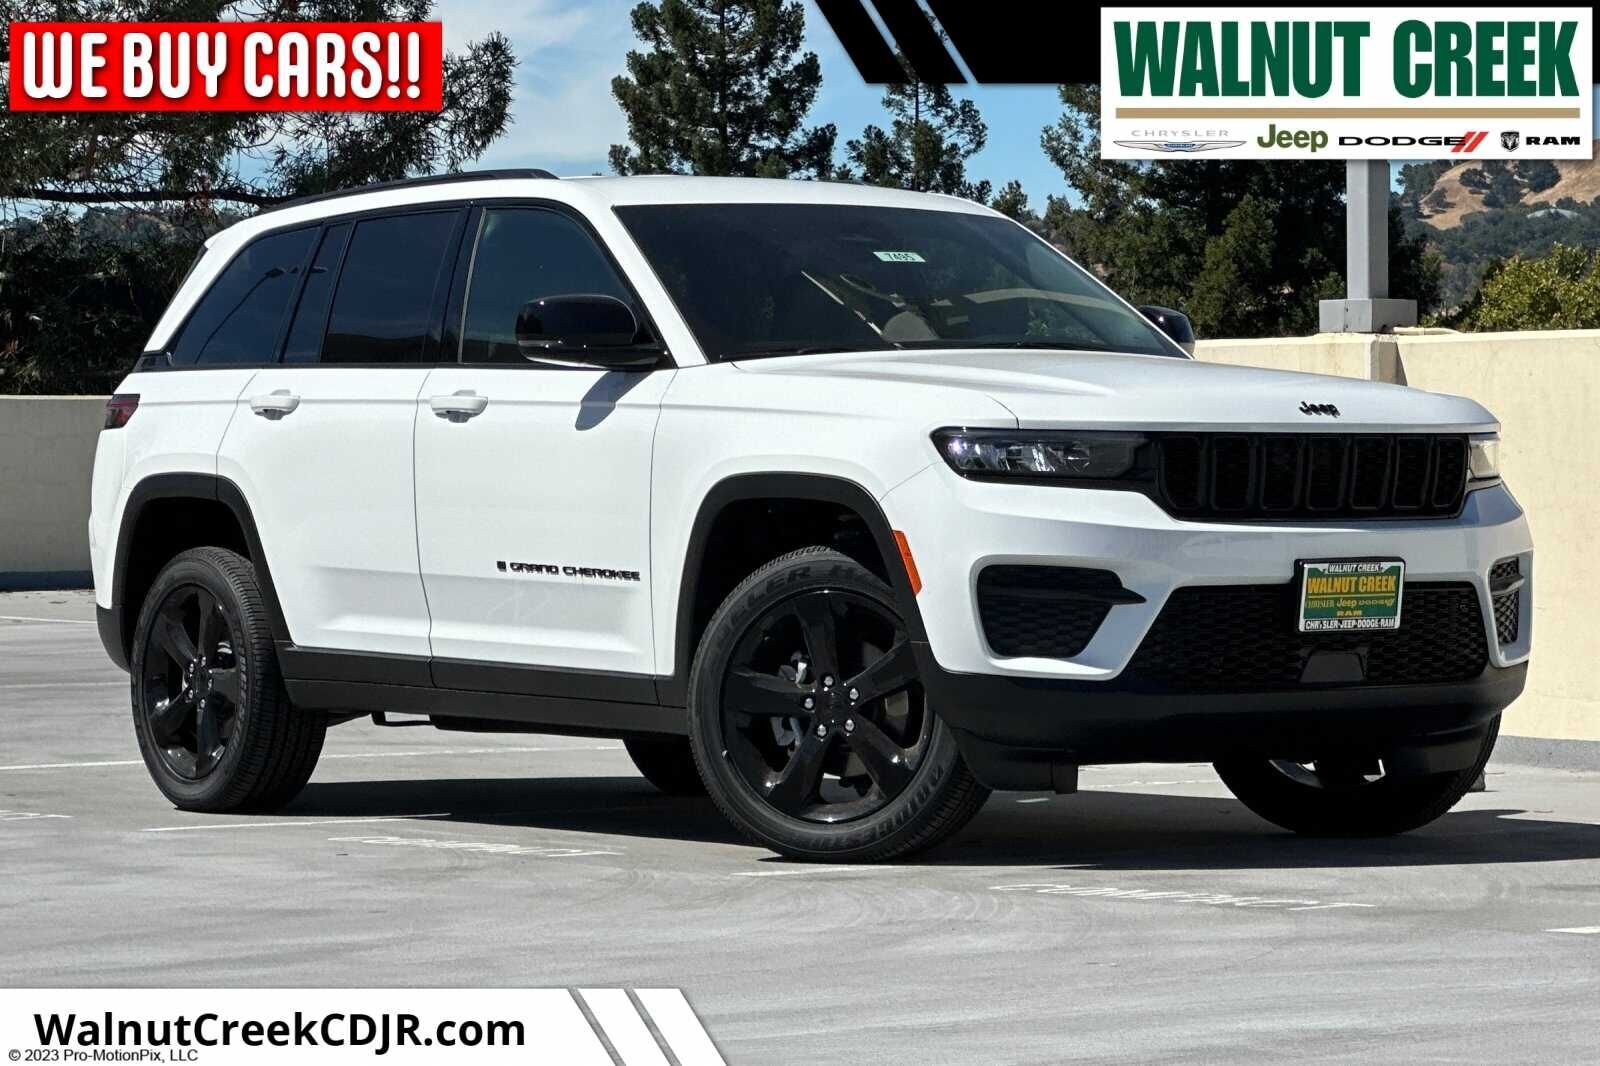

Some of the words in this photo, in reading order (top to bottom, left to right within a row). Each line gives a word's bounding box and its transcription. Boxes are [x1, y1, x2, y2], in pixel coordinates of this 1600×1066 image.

[1299, 401, 1341, 419] Jeep
[509, 562, 559, 575] GRAND
[562, 566, 641, 581] CHEROKEE
[1329, 564, 1356, 573] WALNUT
[1357, 563, 1379, 572] CREEK
[1307, 577, 1358, 593] WALNUT
[1359, 575, 1396, 592] CREEK
